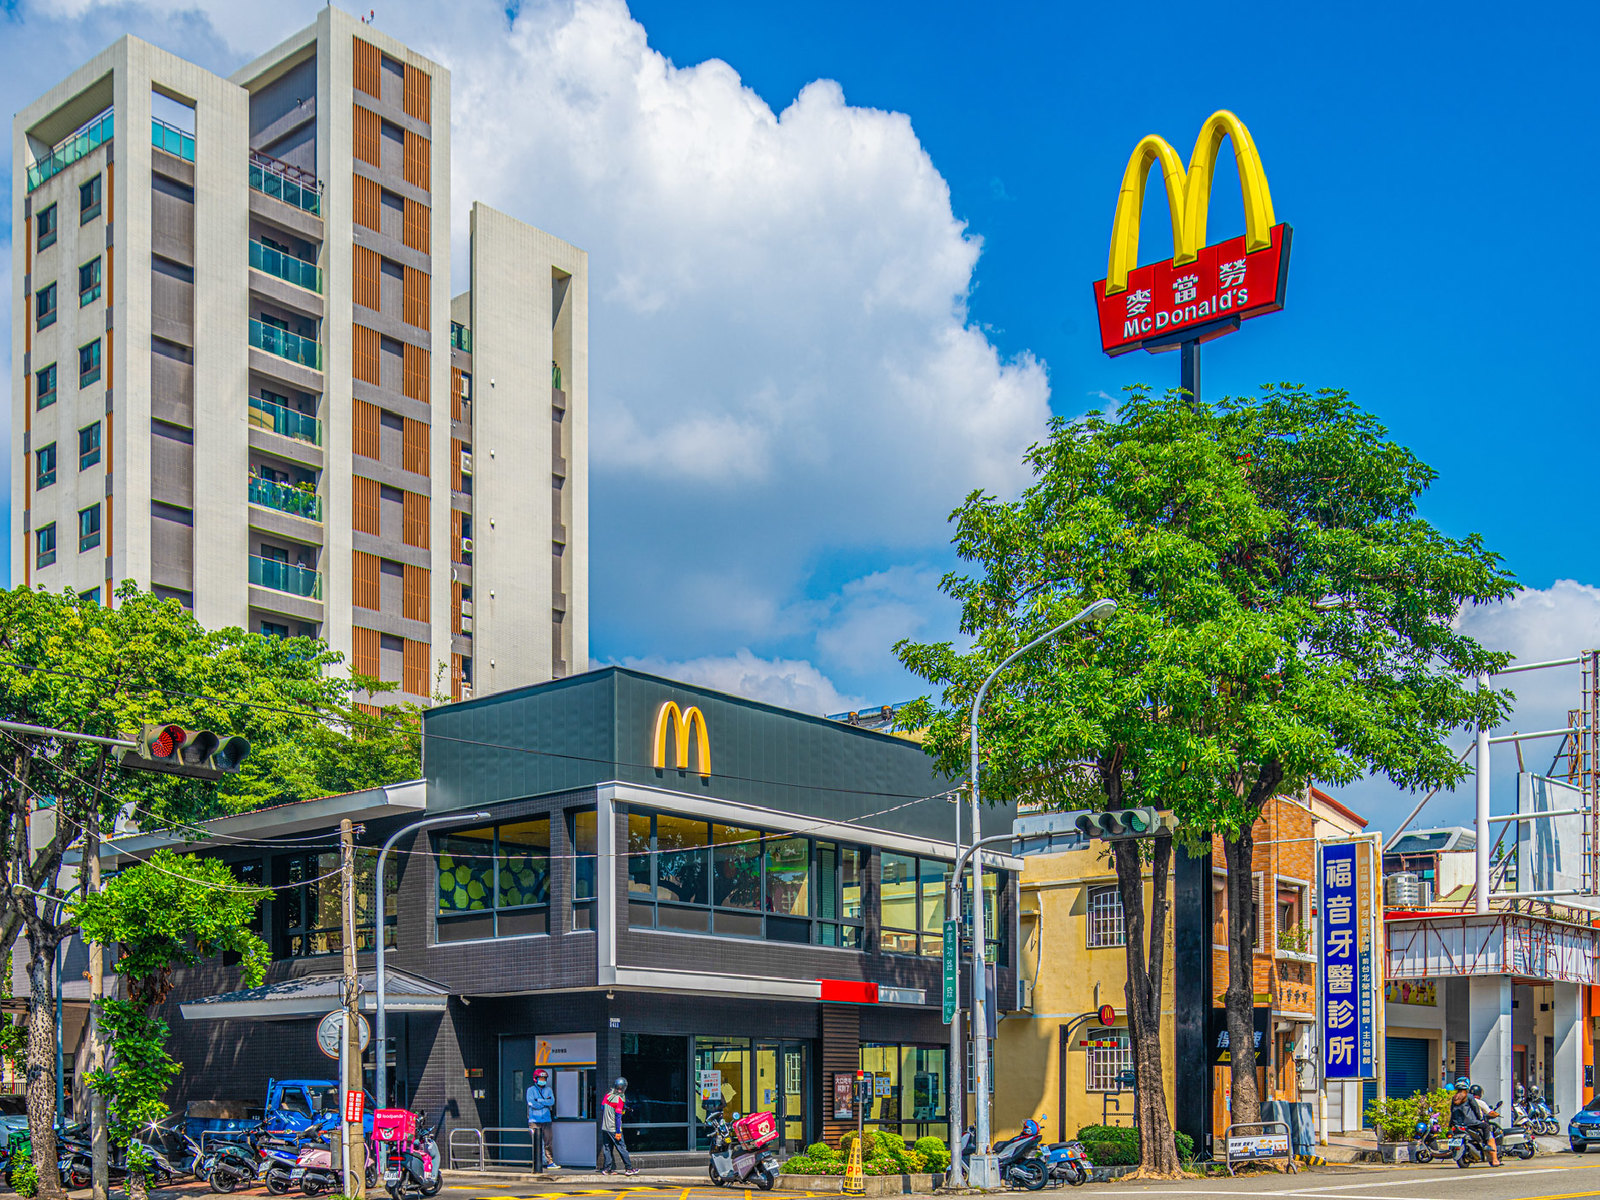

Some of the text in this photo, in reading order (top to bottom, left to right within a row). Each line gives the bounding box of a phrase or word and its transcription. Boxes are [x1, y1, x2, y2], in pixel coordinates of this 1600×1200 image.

[1122, 288, 1249, 339] McDonald's
[1126, 258, 1247, 318] 麥當勞
[1325, 857, 1355, 1066] 福音牙醫診所
[847, 1165, 854, 1175] P
[855, 1166, 861, 1175] P
